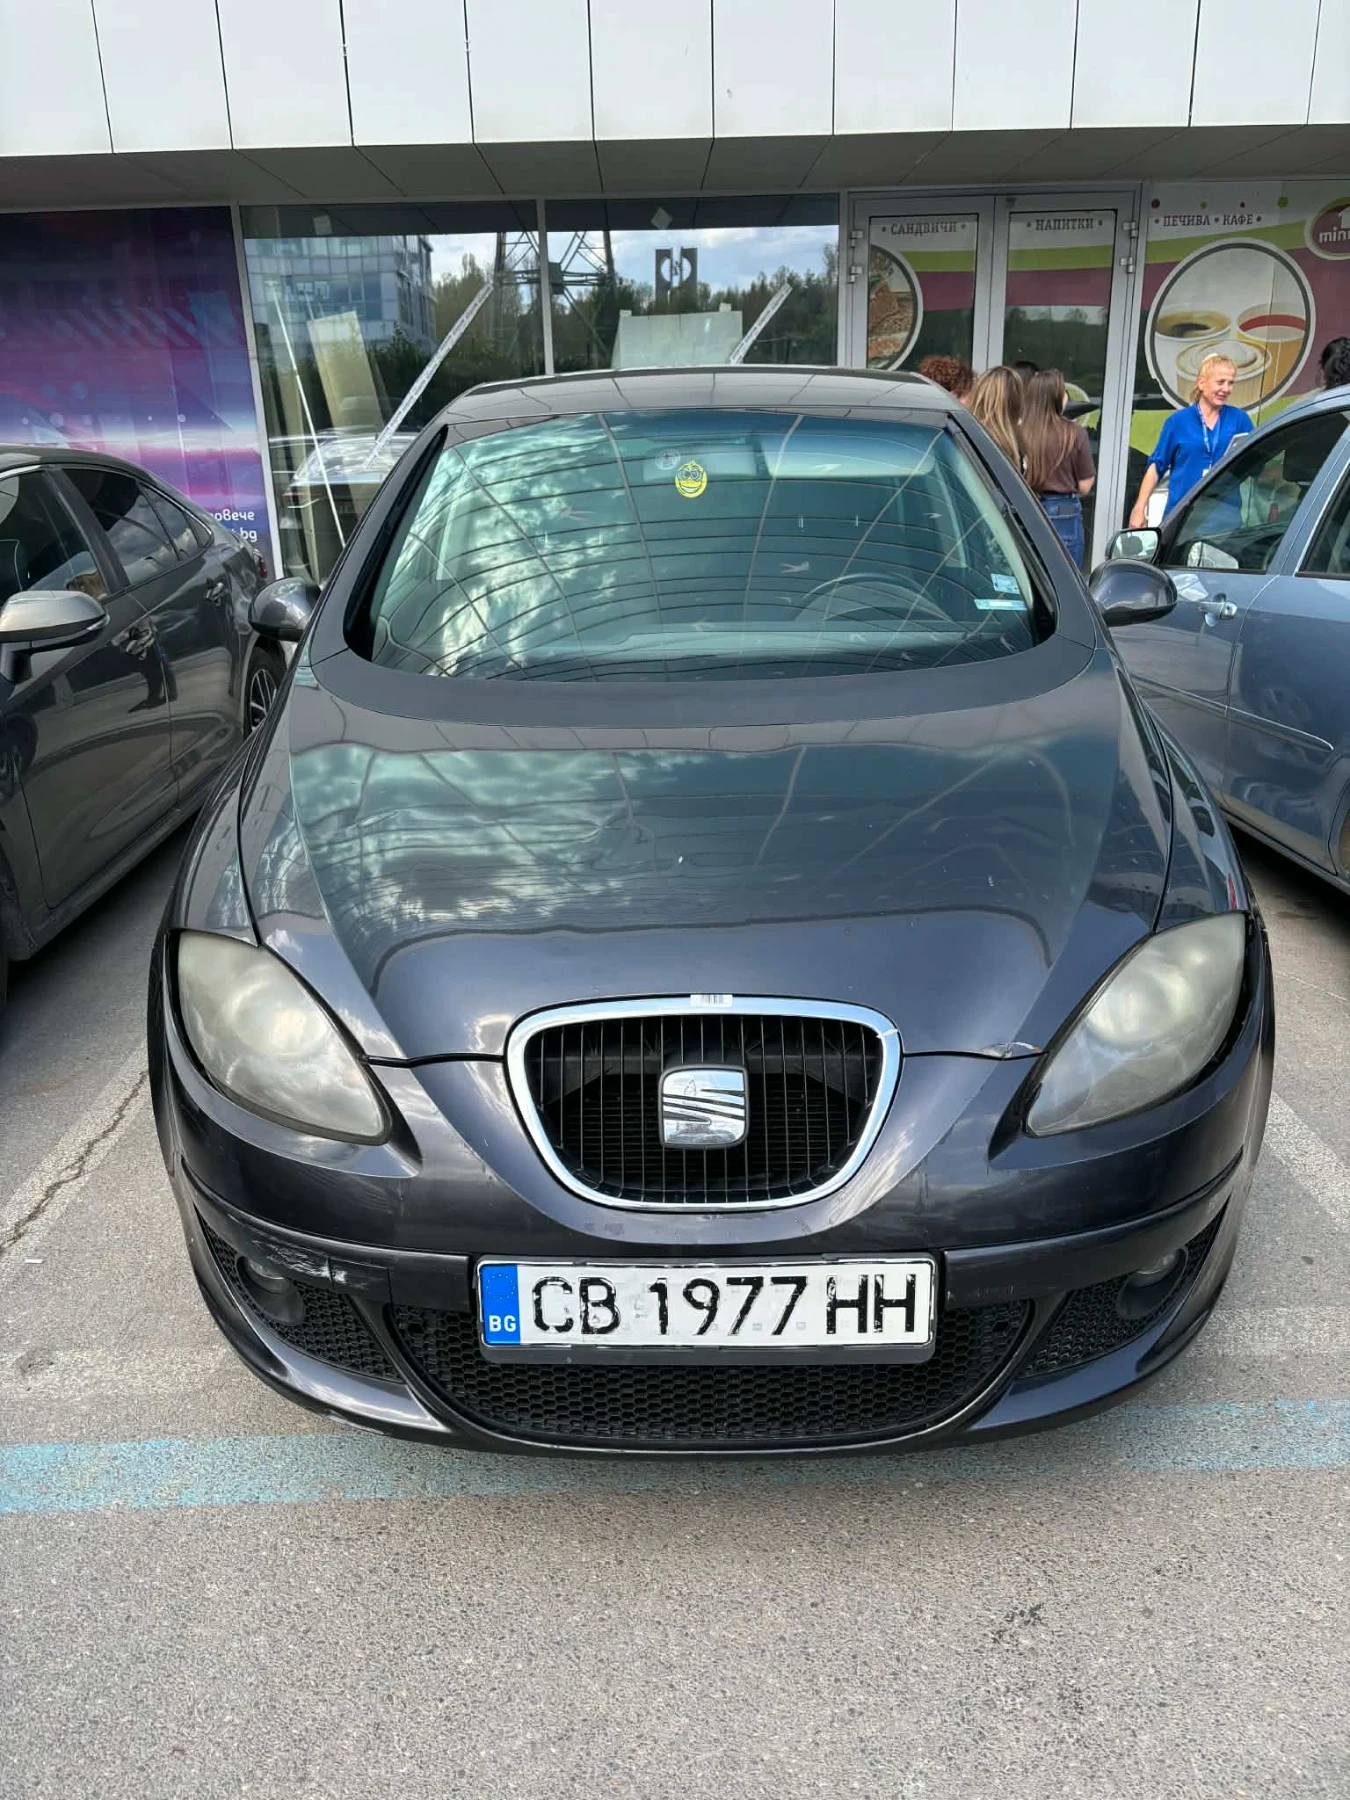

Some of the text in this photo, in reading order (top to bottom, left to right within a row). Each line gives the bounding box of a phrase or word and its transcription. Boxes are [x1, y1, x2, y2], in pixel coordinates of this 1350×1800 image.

[1035, 217, 1094, 231] НАПИТКИ
[1163, 213, 1253, 226] ПЕЧИВА КАФЕ
[891, 221, 957, 236] САНДВИЧИ
[211, 508, 255, 521] овече
[531, 1273, 916, 1336] CB 1977 HH
[488, 1315, 517, 1332] BG
